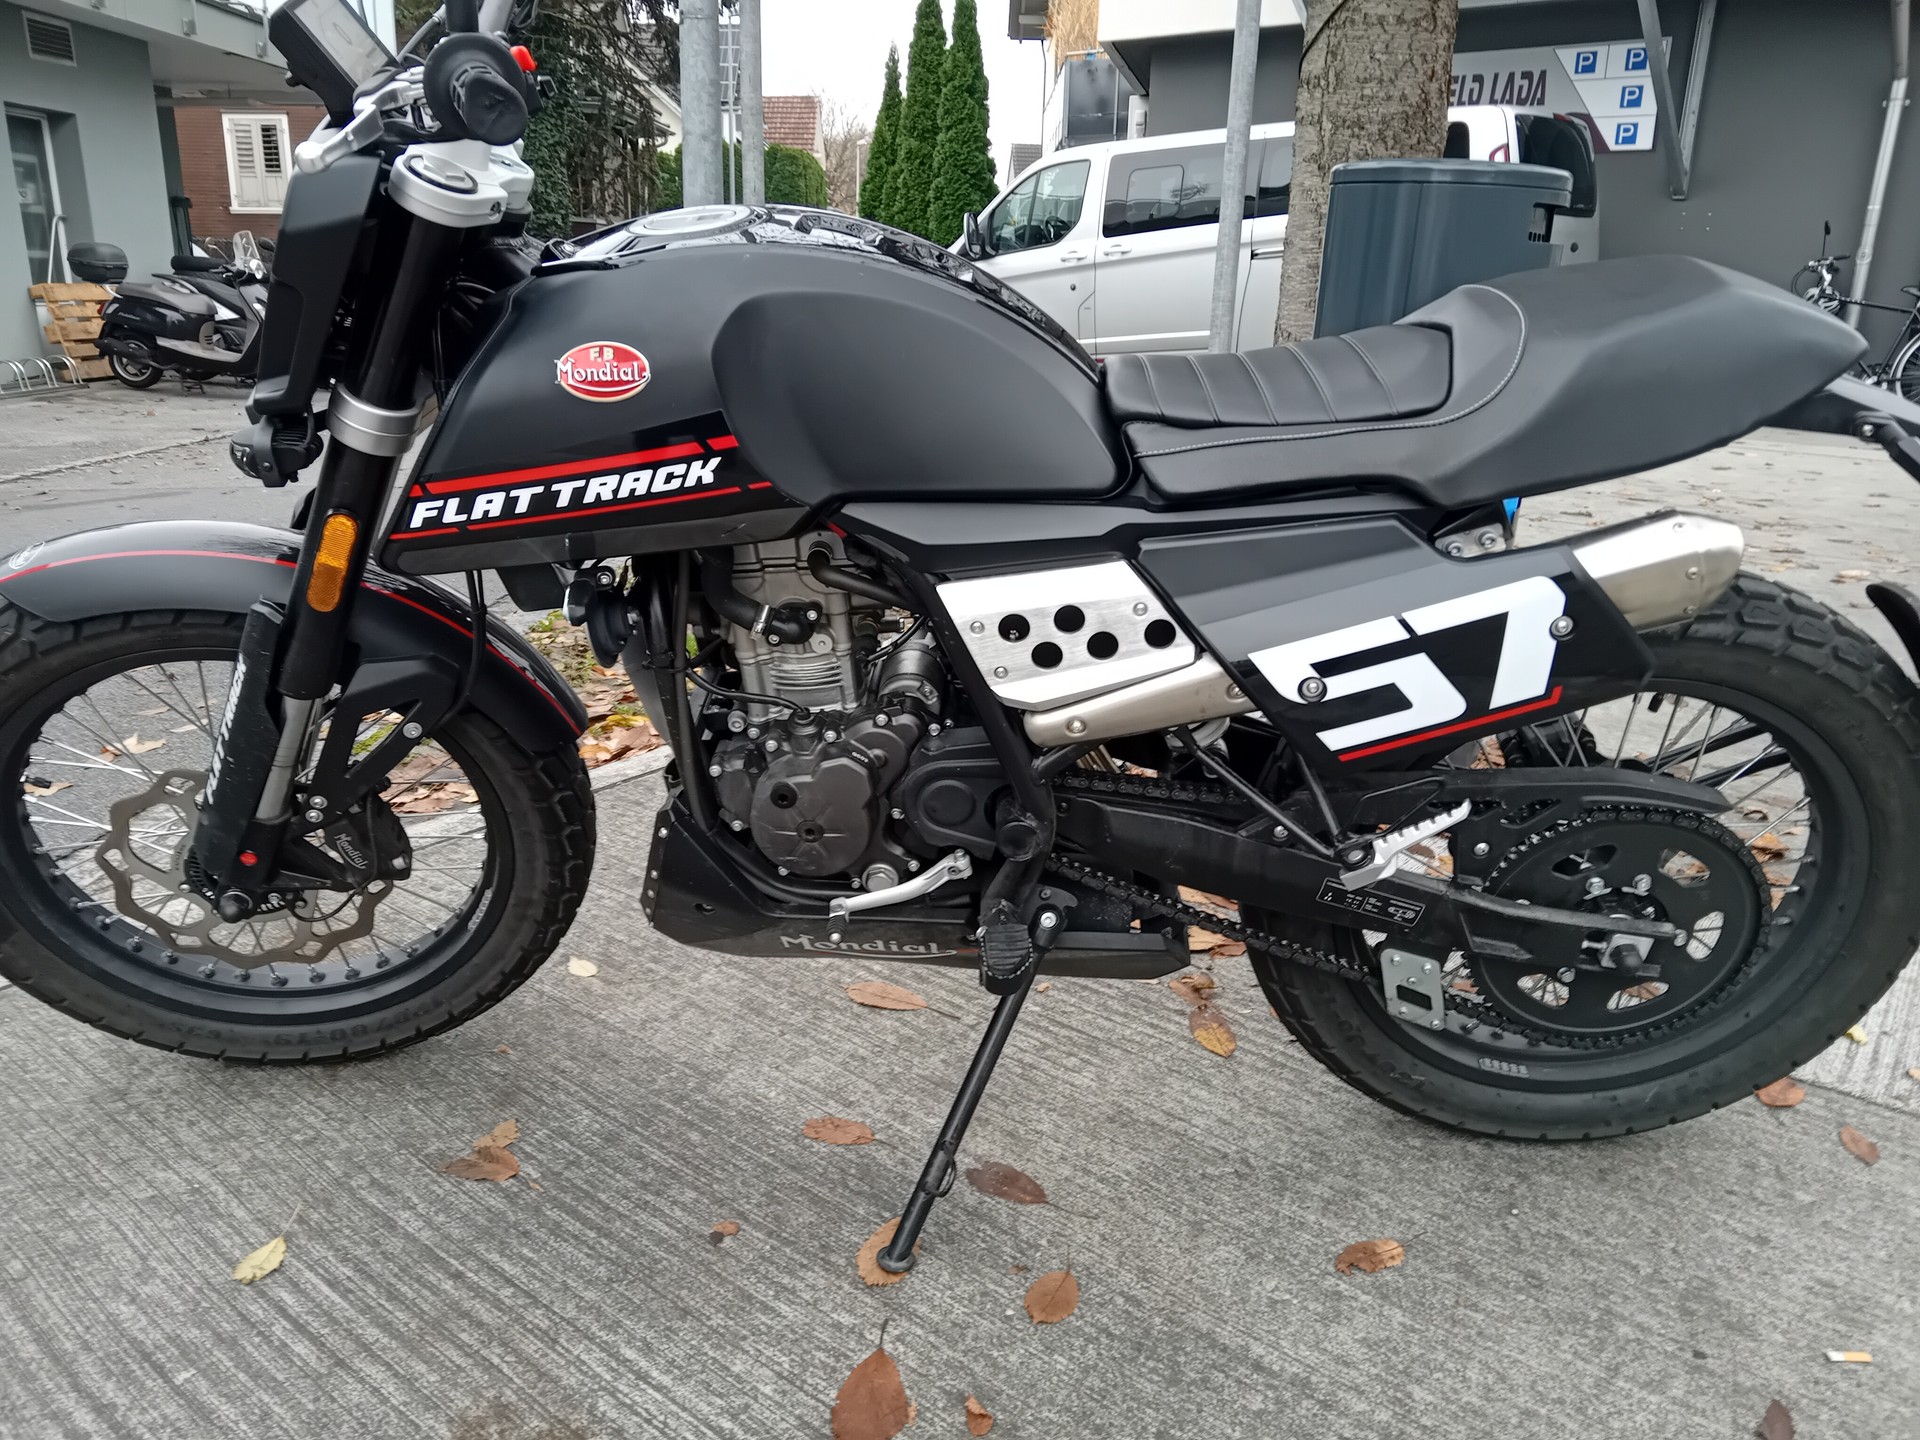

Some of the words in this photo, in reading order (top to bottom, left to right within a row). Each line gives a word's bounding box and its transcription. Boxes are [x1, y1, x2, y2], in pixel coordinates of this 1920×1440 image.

[1578, 52, 1594, 73] P
[1628, 49, 1645, 71] P
[1489, 69, 1548, 106] LADA
[1622, 87, 1640, 107] P
[1618, 124, 1635, 144] P
[554, 356, 651, 392] Mondial
[409, 486, 544, 529] FLAT
[551, 456, 722, 509] TRACK
[1247, 575, 1567, 752] 57
[205, 734, 225, 805] FLAT
[333, 833, 369, 869] Mondial
[779, 934, 958, 959] Mondial
